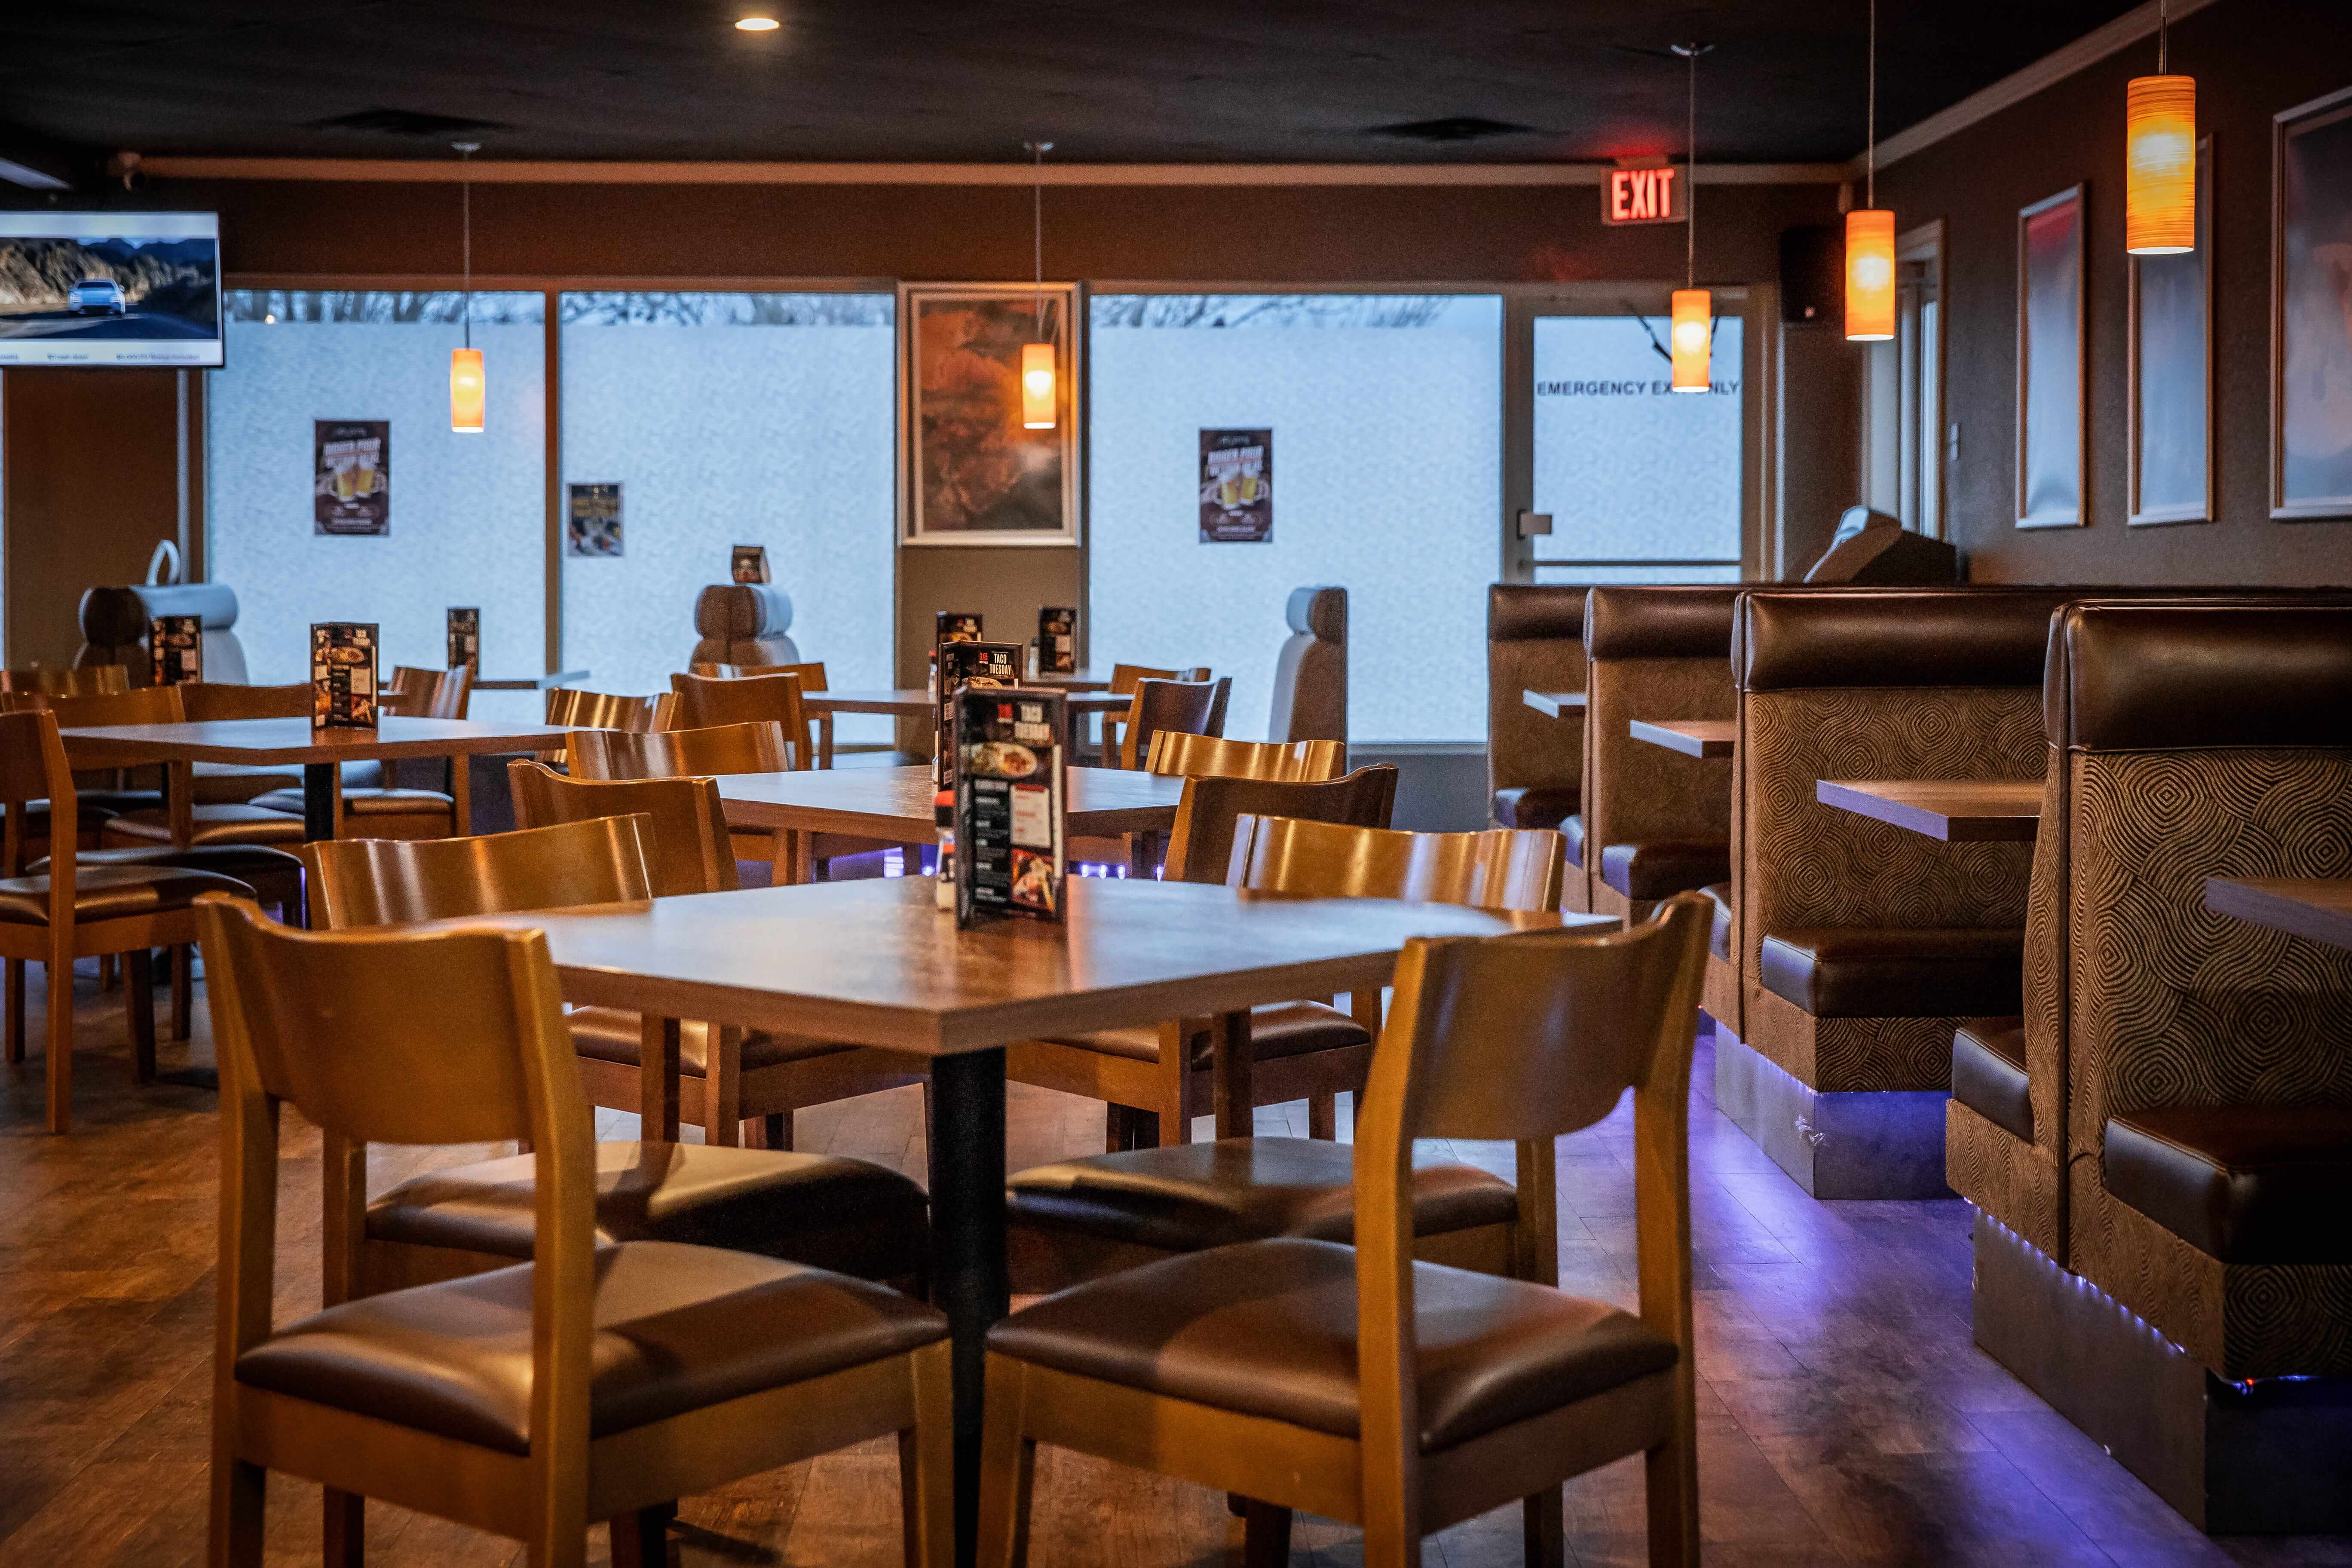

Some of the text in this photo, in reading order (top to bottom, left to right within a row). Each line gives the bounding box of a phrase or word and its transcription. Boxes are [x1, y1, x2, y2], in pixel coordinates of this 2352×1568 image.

[1611, 168, 1675, 220] EXIT
[1537, 380, 1740, 396] EMERGENCY EX NLY
[994, 653, 1007, 664] TACO
[989, 664, 1011, 675] TUESDAY
